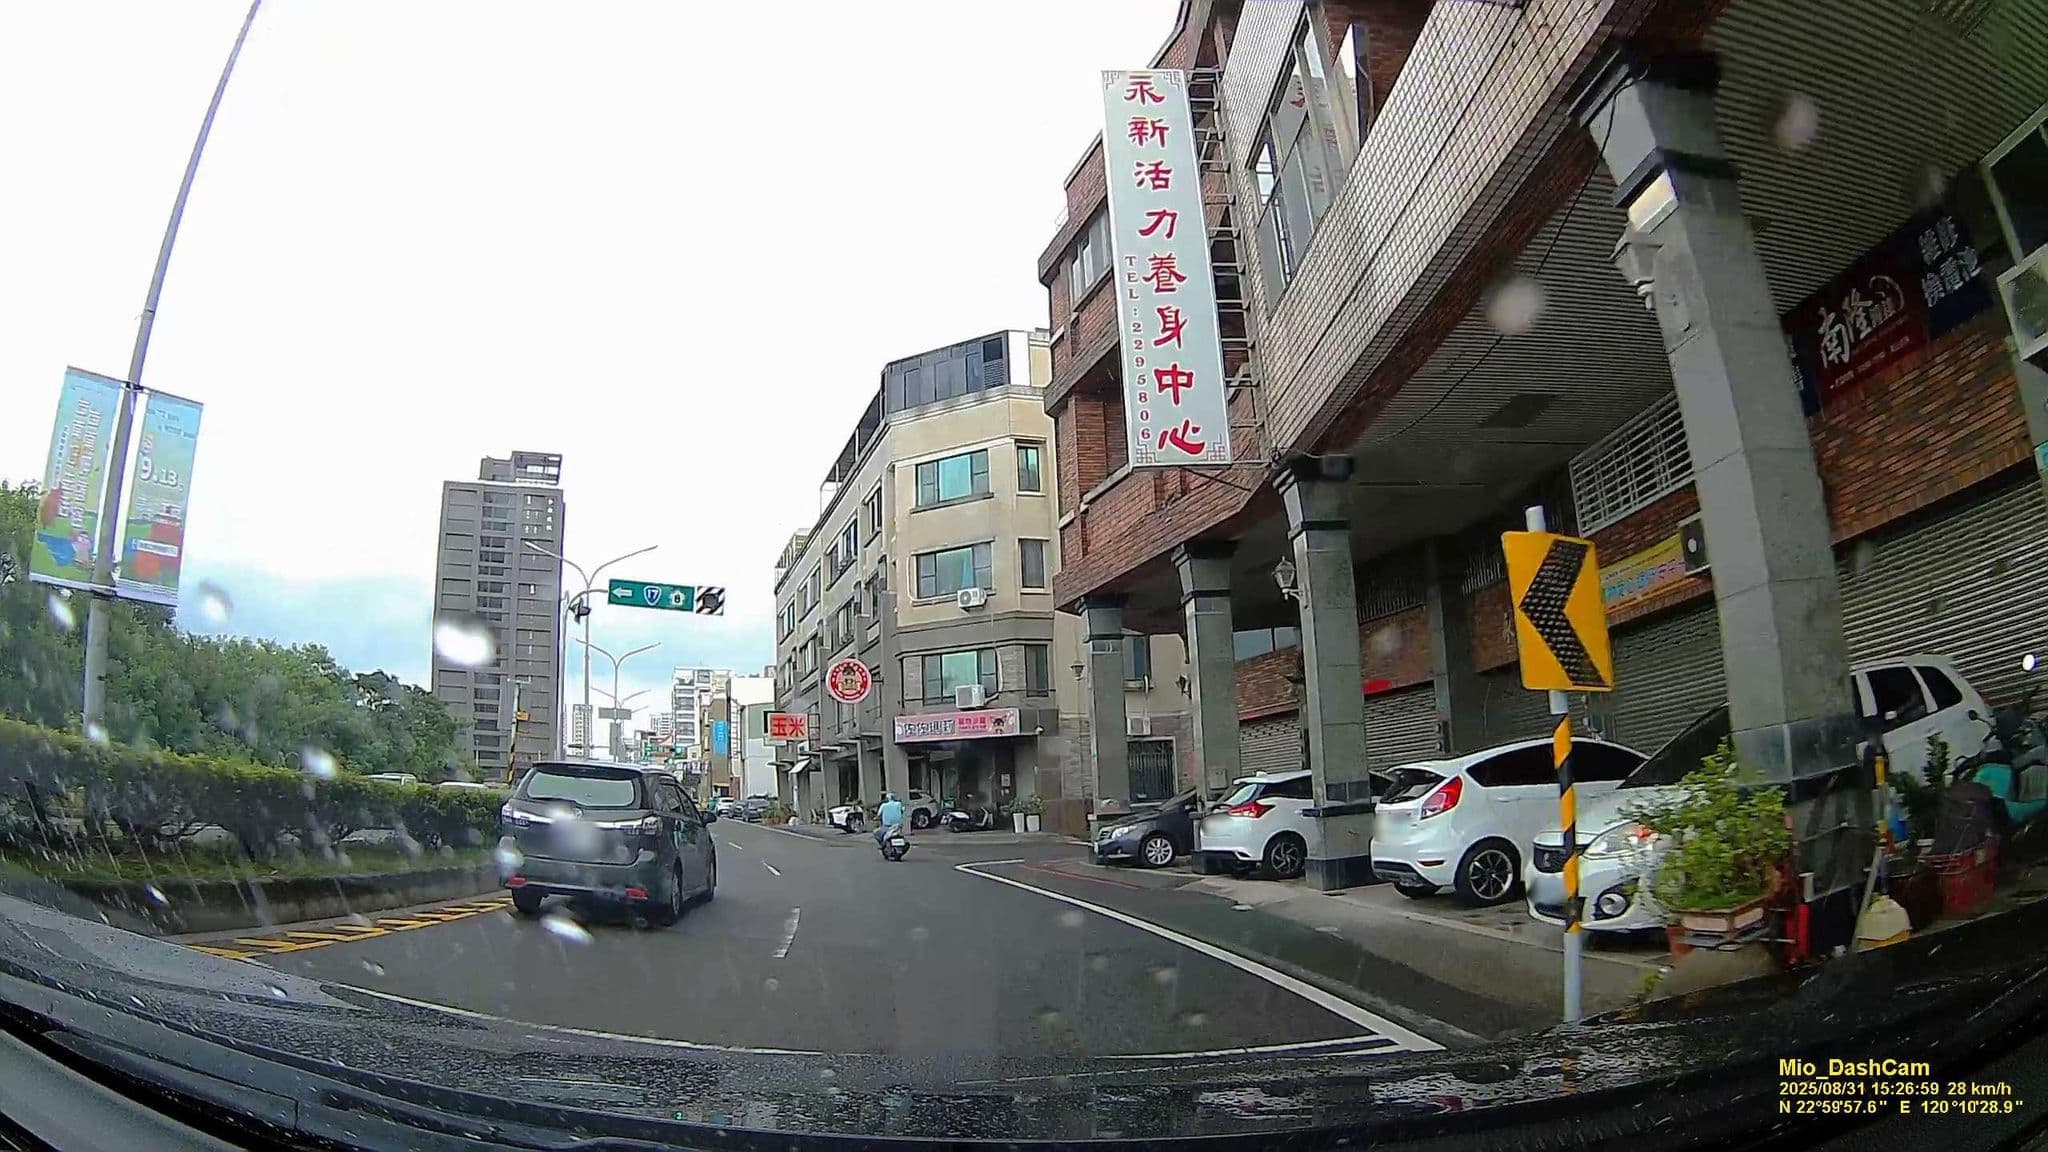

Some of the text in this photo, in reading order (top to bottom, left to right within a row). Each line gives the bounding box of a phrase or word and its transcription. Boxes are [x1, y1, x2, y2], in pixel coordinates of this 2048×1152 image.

[1124, 75, 1206, 455] 永新活力養身中心
[1124, 255, 1151, 440] TEL:2295806
[771, 715, 805, 737] 玉米
